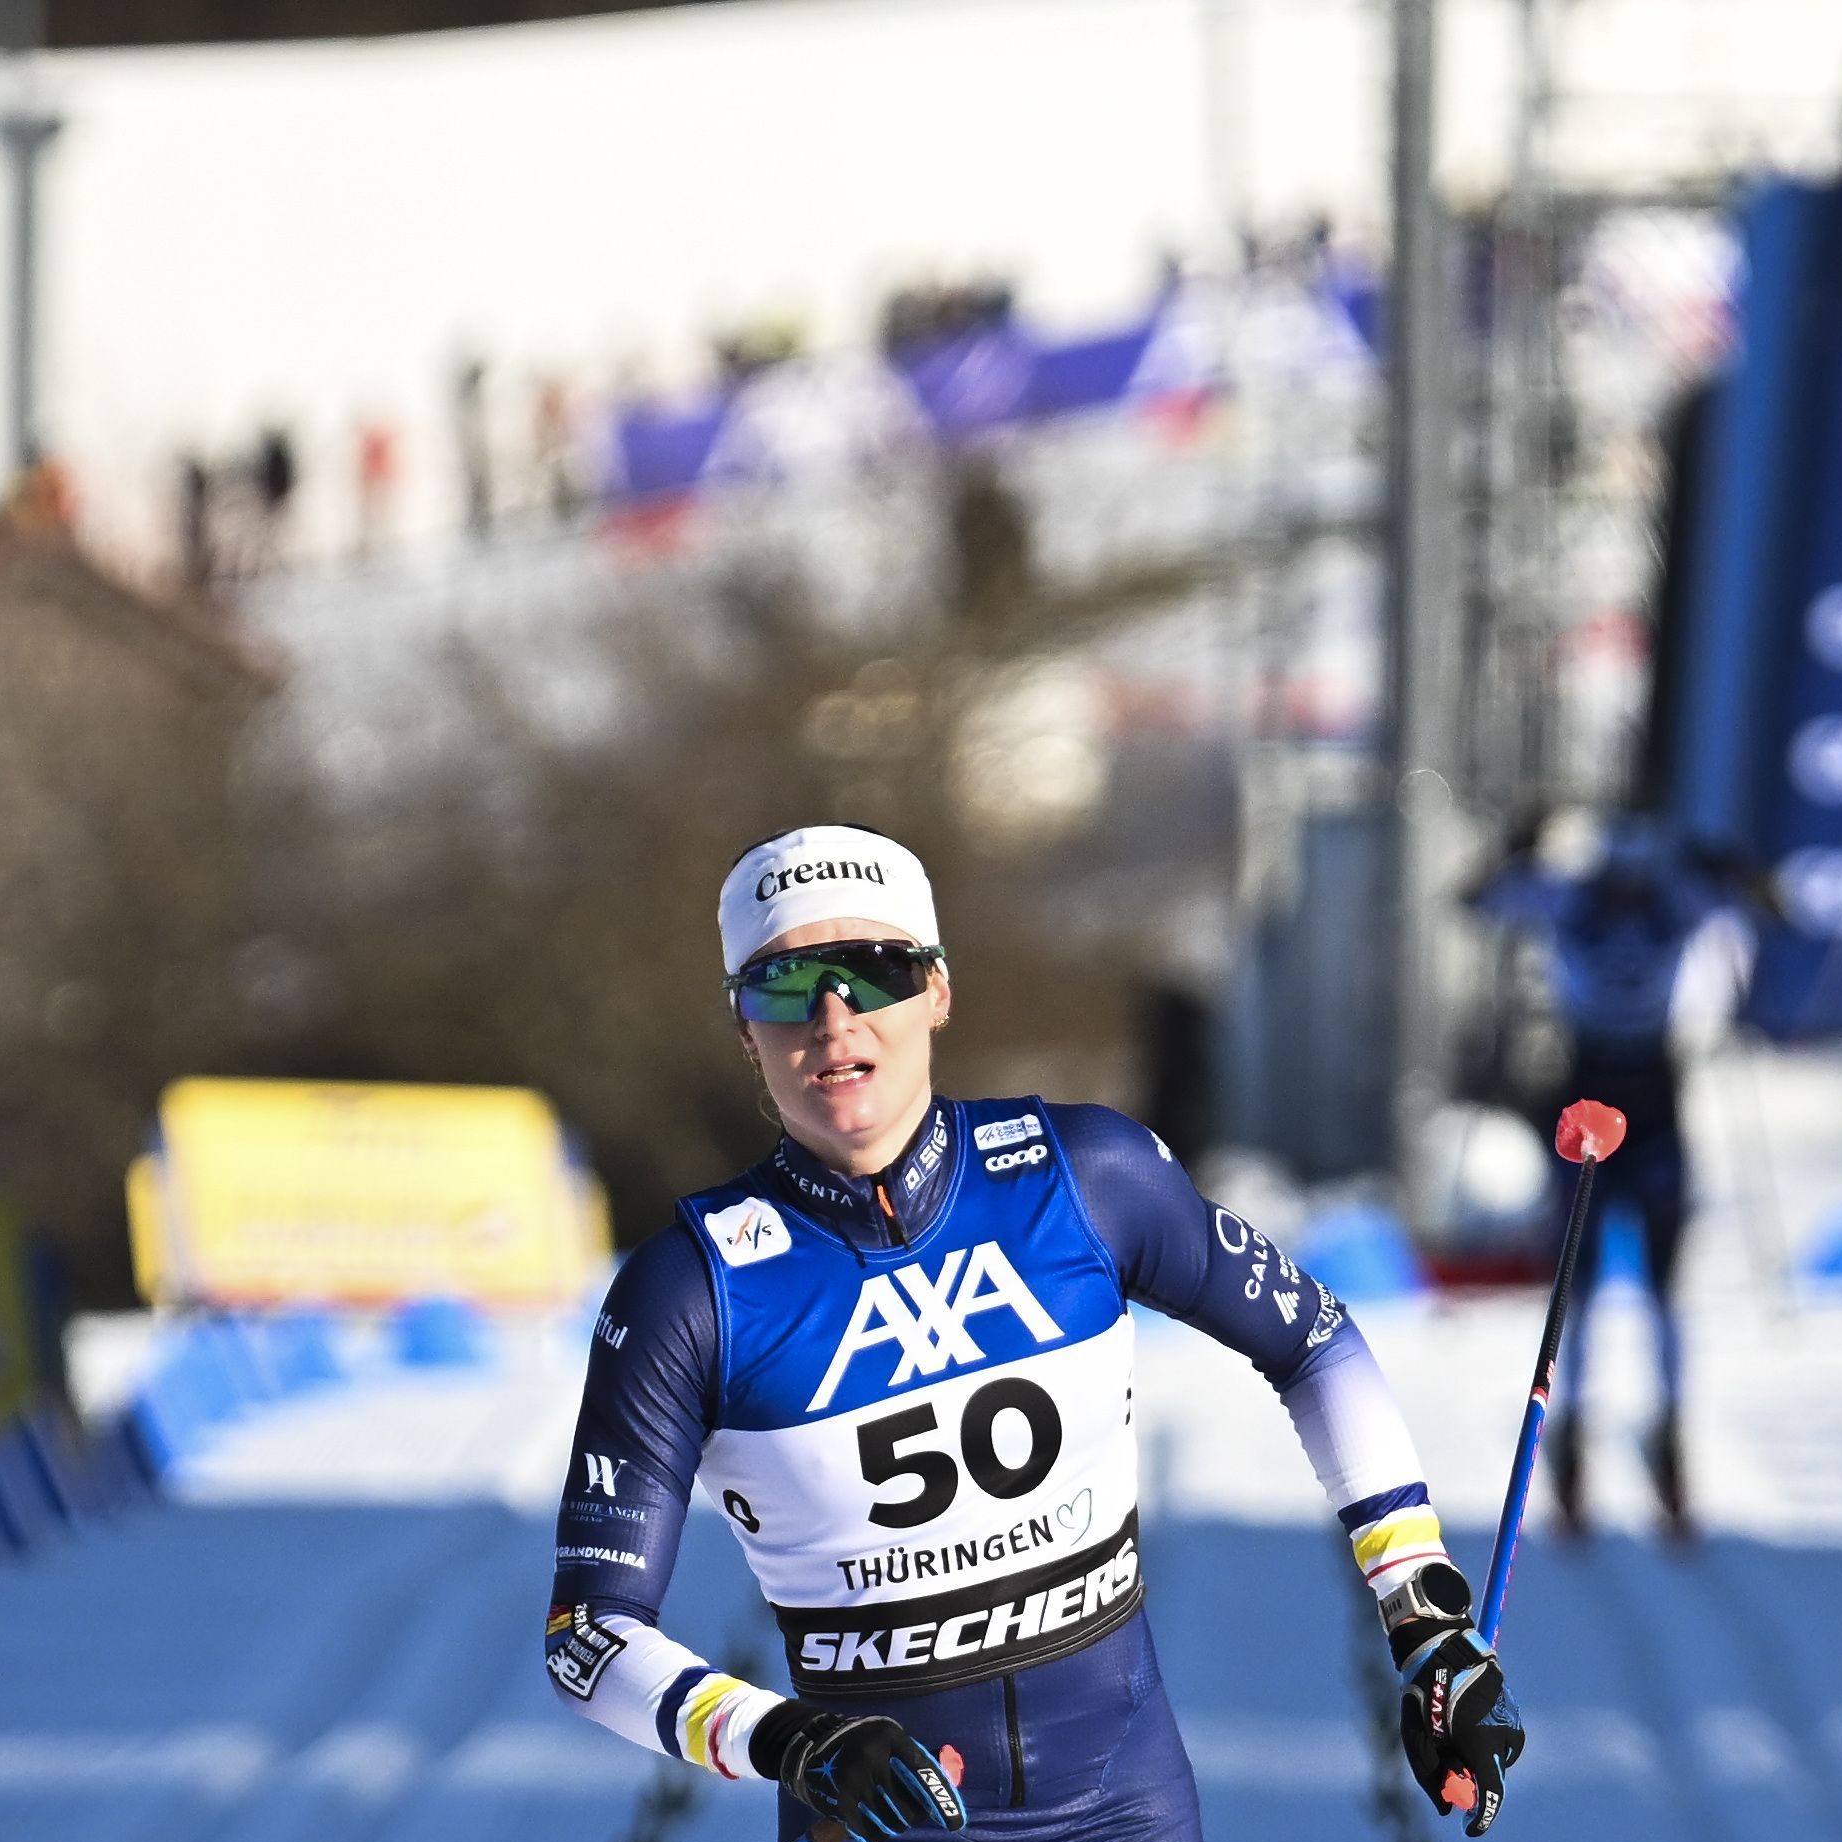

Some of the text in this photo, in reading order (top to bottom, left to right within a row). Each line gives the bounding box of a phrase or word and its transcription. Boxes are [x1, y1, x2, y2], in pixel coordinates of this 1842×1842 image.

[754, 859, 885, 903] Creand
[984, 1144, 1049, 1173] coop
[726, 1223, 772, 1246] FIS
[806, 1241, 1064, 1412] AXA
[855, 1377, 1063, 1530] 50
[605, 1504, 648, 1523] ANGEL
[836, 1515, 1055, 1593] THÜRINGEN
[799, 1539, 1140, 1673] SKECHERS
[917, 1767, 960, 1817] KV+
